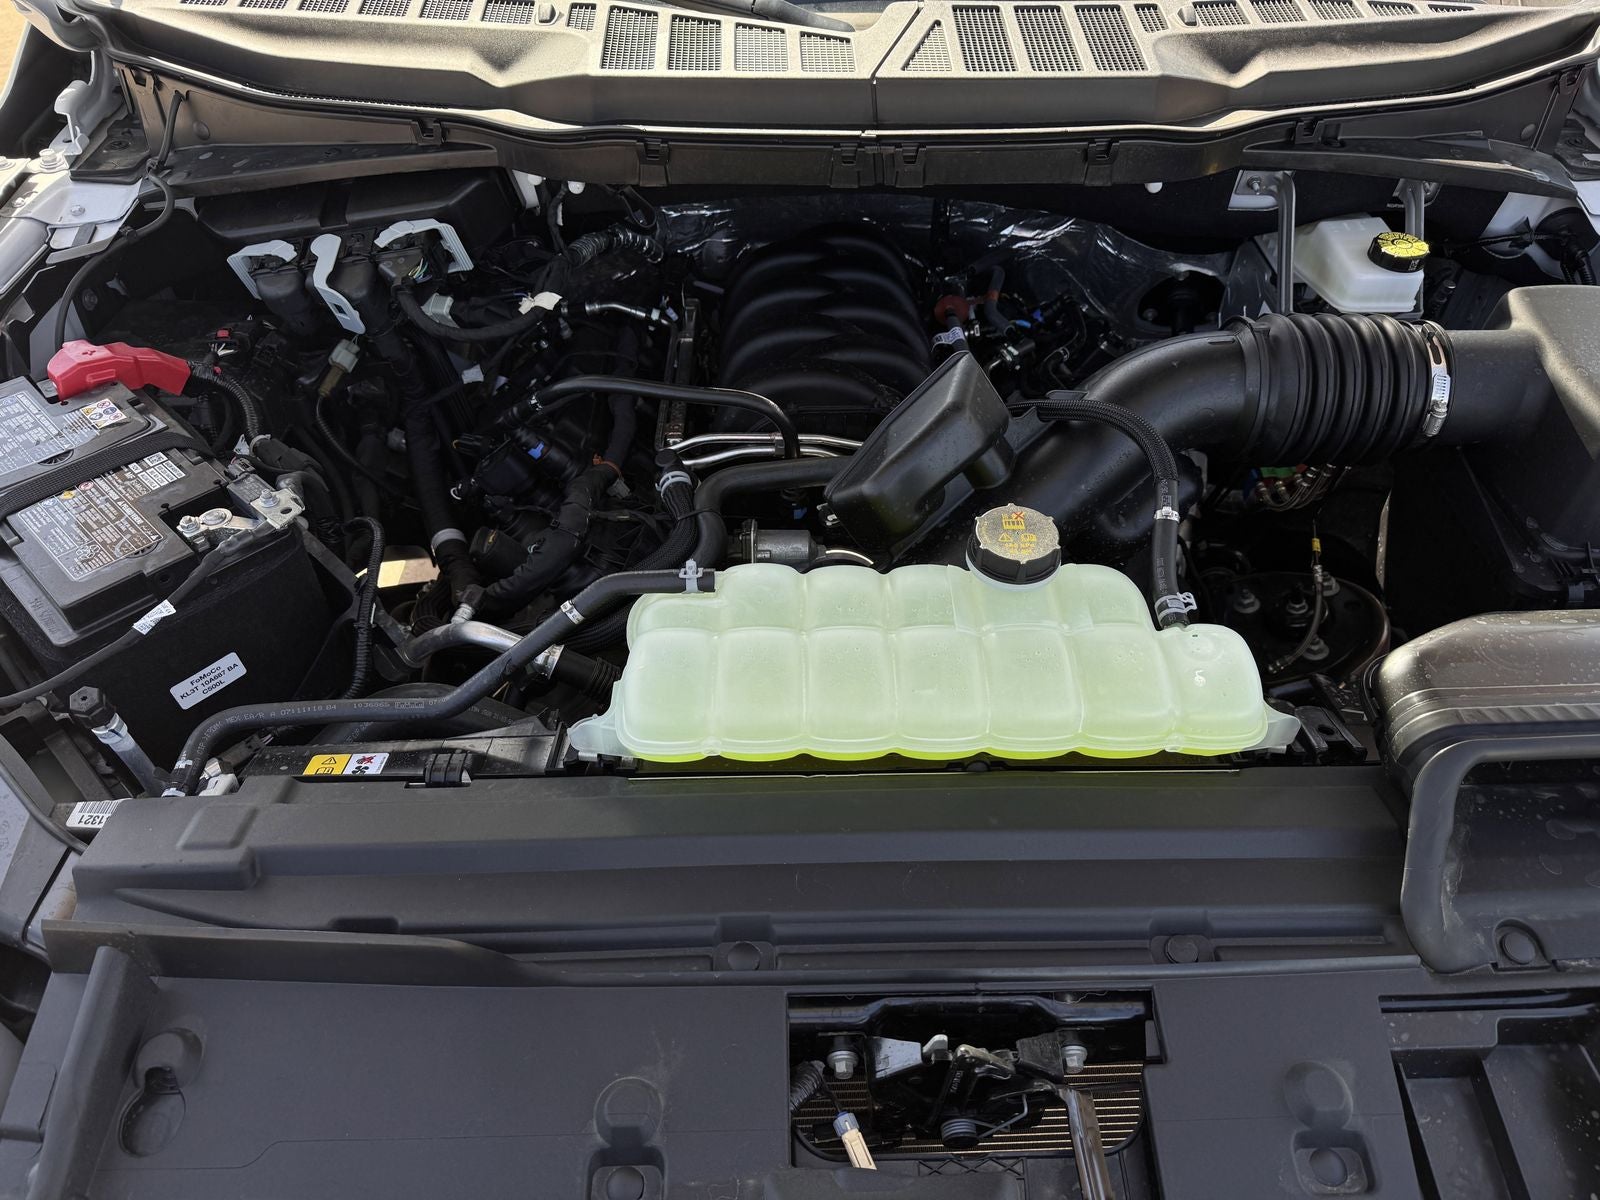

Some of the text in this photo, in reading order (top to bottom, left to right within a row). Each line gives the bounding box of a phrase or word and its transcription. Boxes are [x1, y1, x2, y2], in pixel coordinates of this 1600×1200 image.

[180, 686, 199, 700] KL3T
[227, 663, 239, 672] BA
[190, 666, 221, 686] FoMoCo
[202, 680, 225, 695] C500L
[77, 814, 111, 826] 1321
